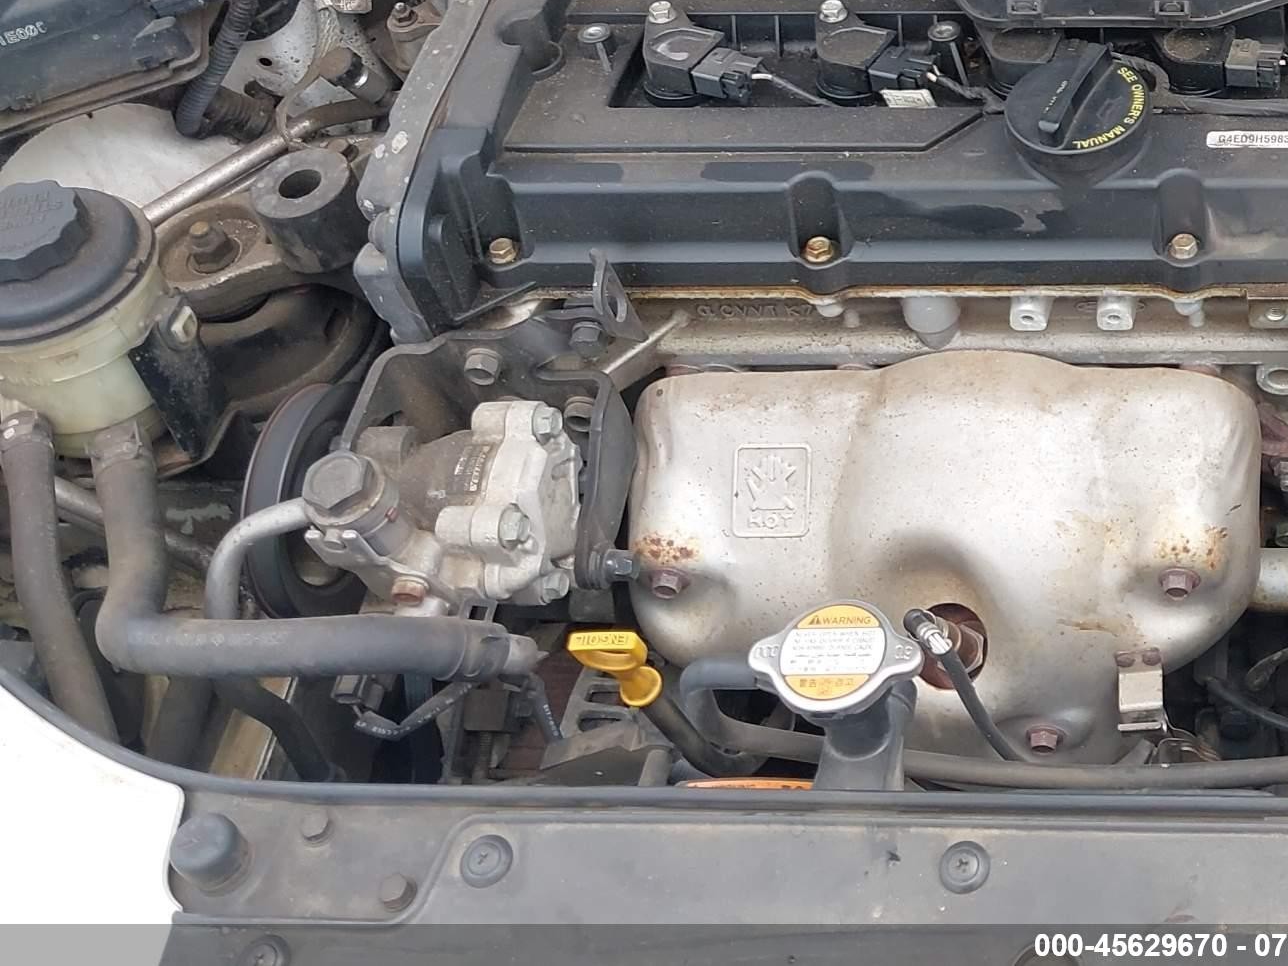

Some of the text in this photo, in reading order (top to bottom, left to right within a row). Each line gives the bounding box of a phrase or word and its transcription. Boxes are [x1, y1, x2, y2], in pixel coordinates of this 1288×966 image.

[1072, 66, 1145, 149] SEE OWNER'S MANUAL
[822, 616, 872, 625] WARNING
